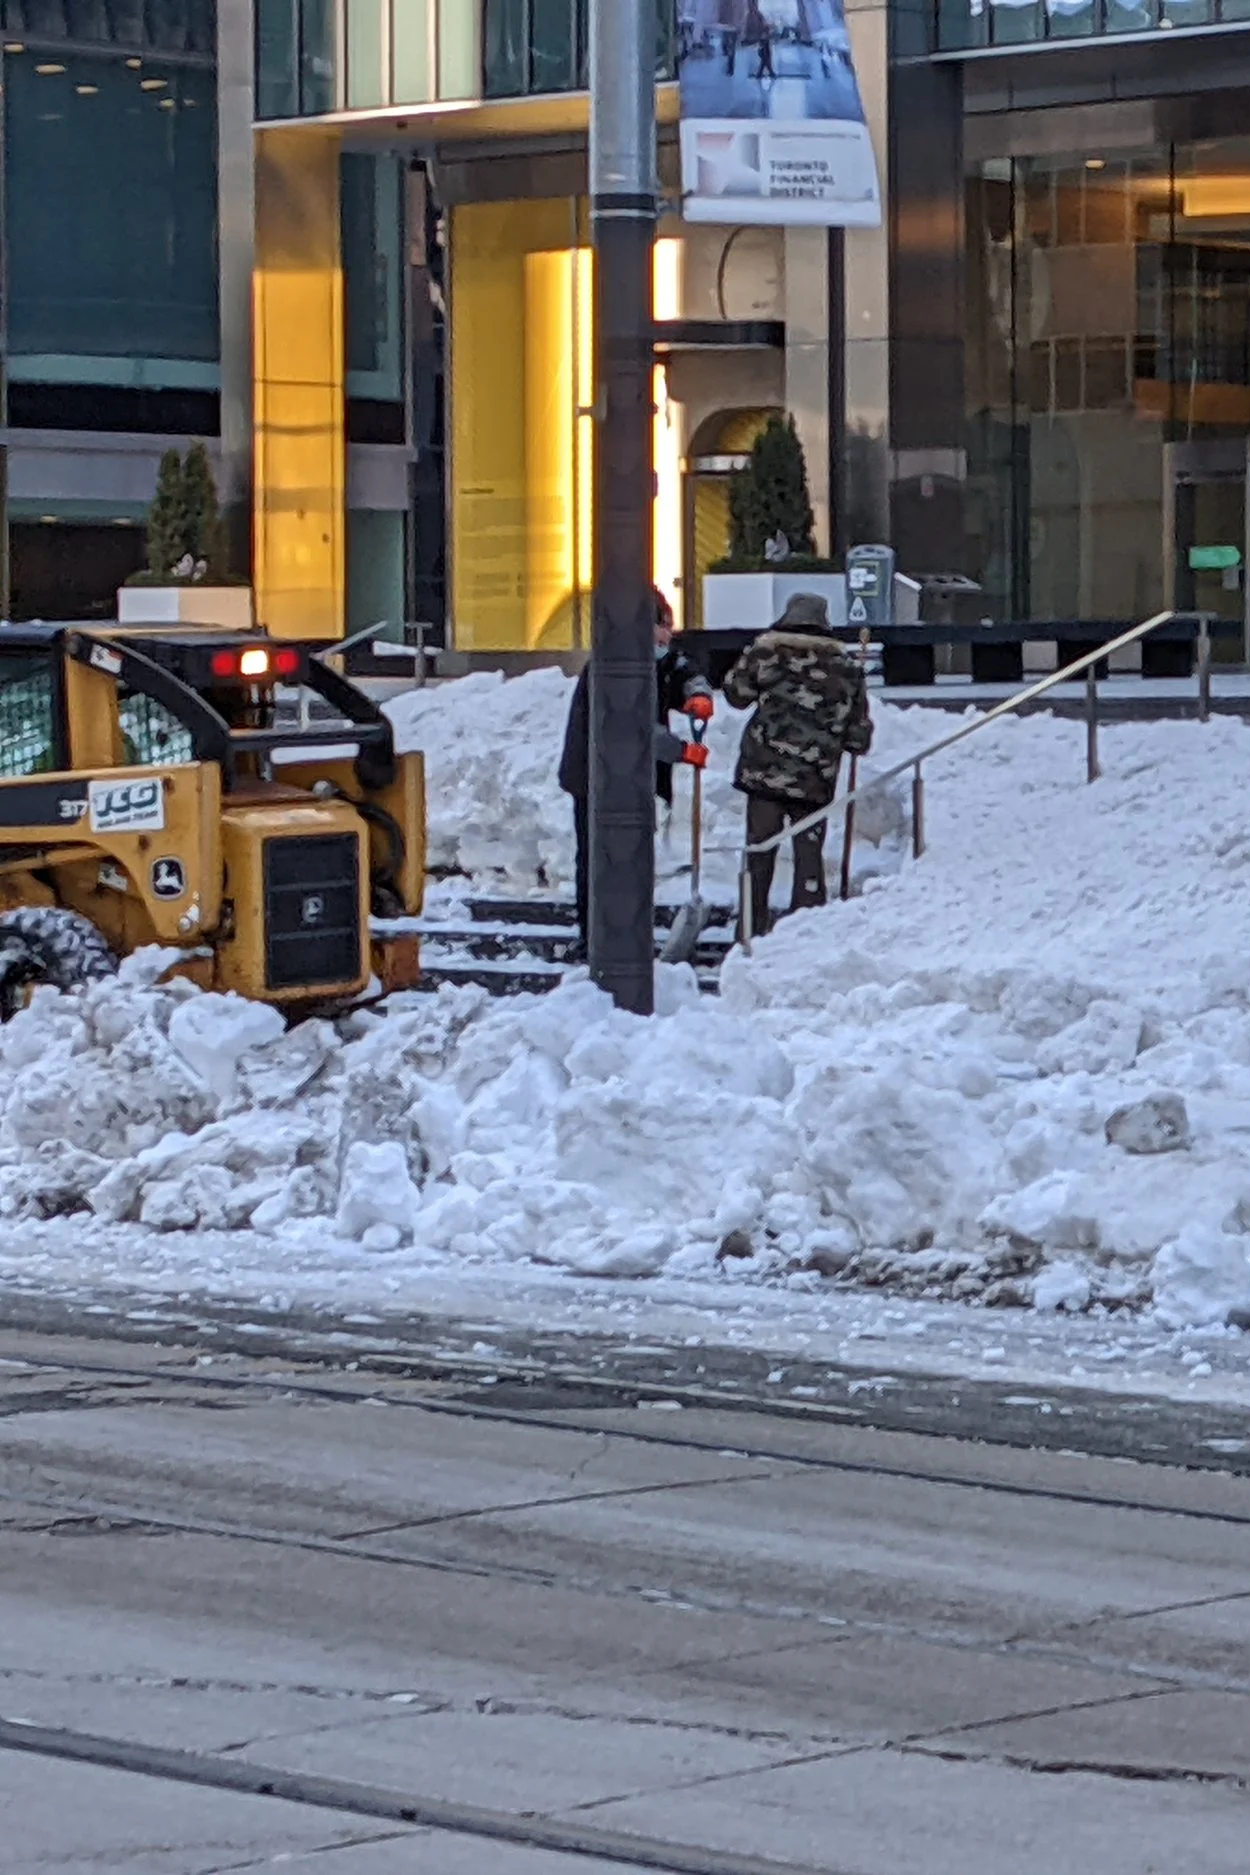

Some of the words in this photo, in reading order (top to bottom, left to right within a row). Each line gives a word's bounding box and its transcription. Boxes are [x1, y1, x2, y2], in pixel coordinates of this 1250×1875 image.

[769, 160, 829, 173] TORONTO
[769, 174, 835, 186] FINANCIAL
[769, 186, 825, 198] DISTRICT
